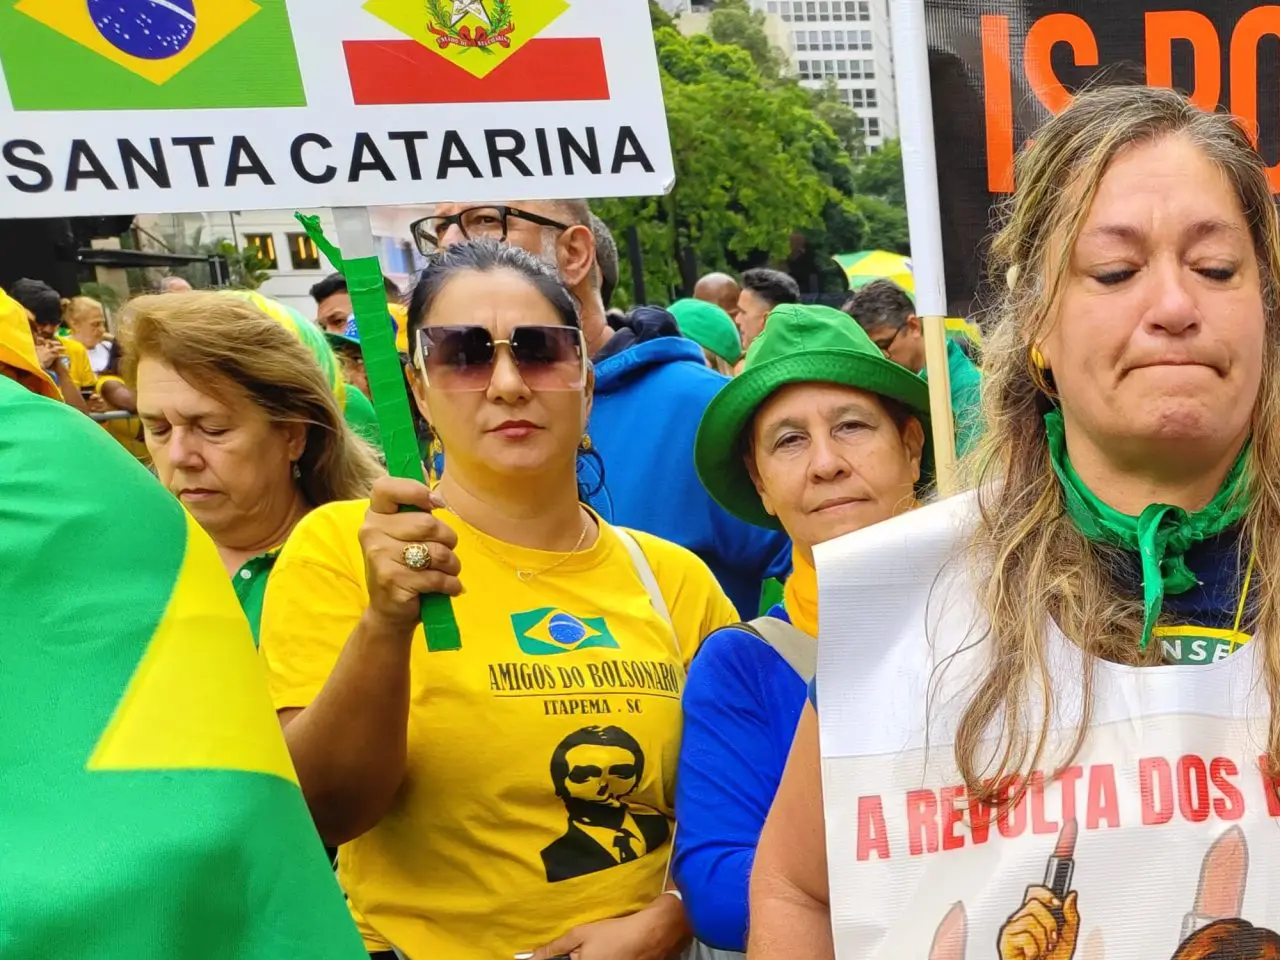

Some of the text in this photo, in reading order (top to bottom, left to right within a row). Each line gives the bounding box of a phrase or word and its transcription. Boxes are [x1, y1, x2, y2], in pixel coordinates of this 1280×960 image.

[2, 125, 656, 193] SANTA CATARINA
[488, 659, 680, 694] AMIGOS DO BOLSONARO
[543, 699, 611, 716] ITAPEMA
[627, 698, 643, 714] SC
[857, 795, 891, 862] A
[906, 763, 1121, 856] REVOLTA
[1139, 753, 1244, 826] DOS
